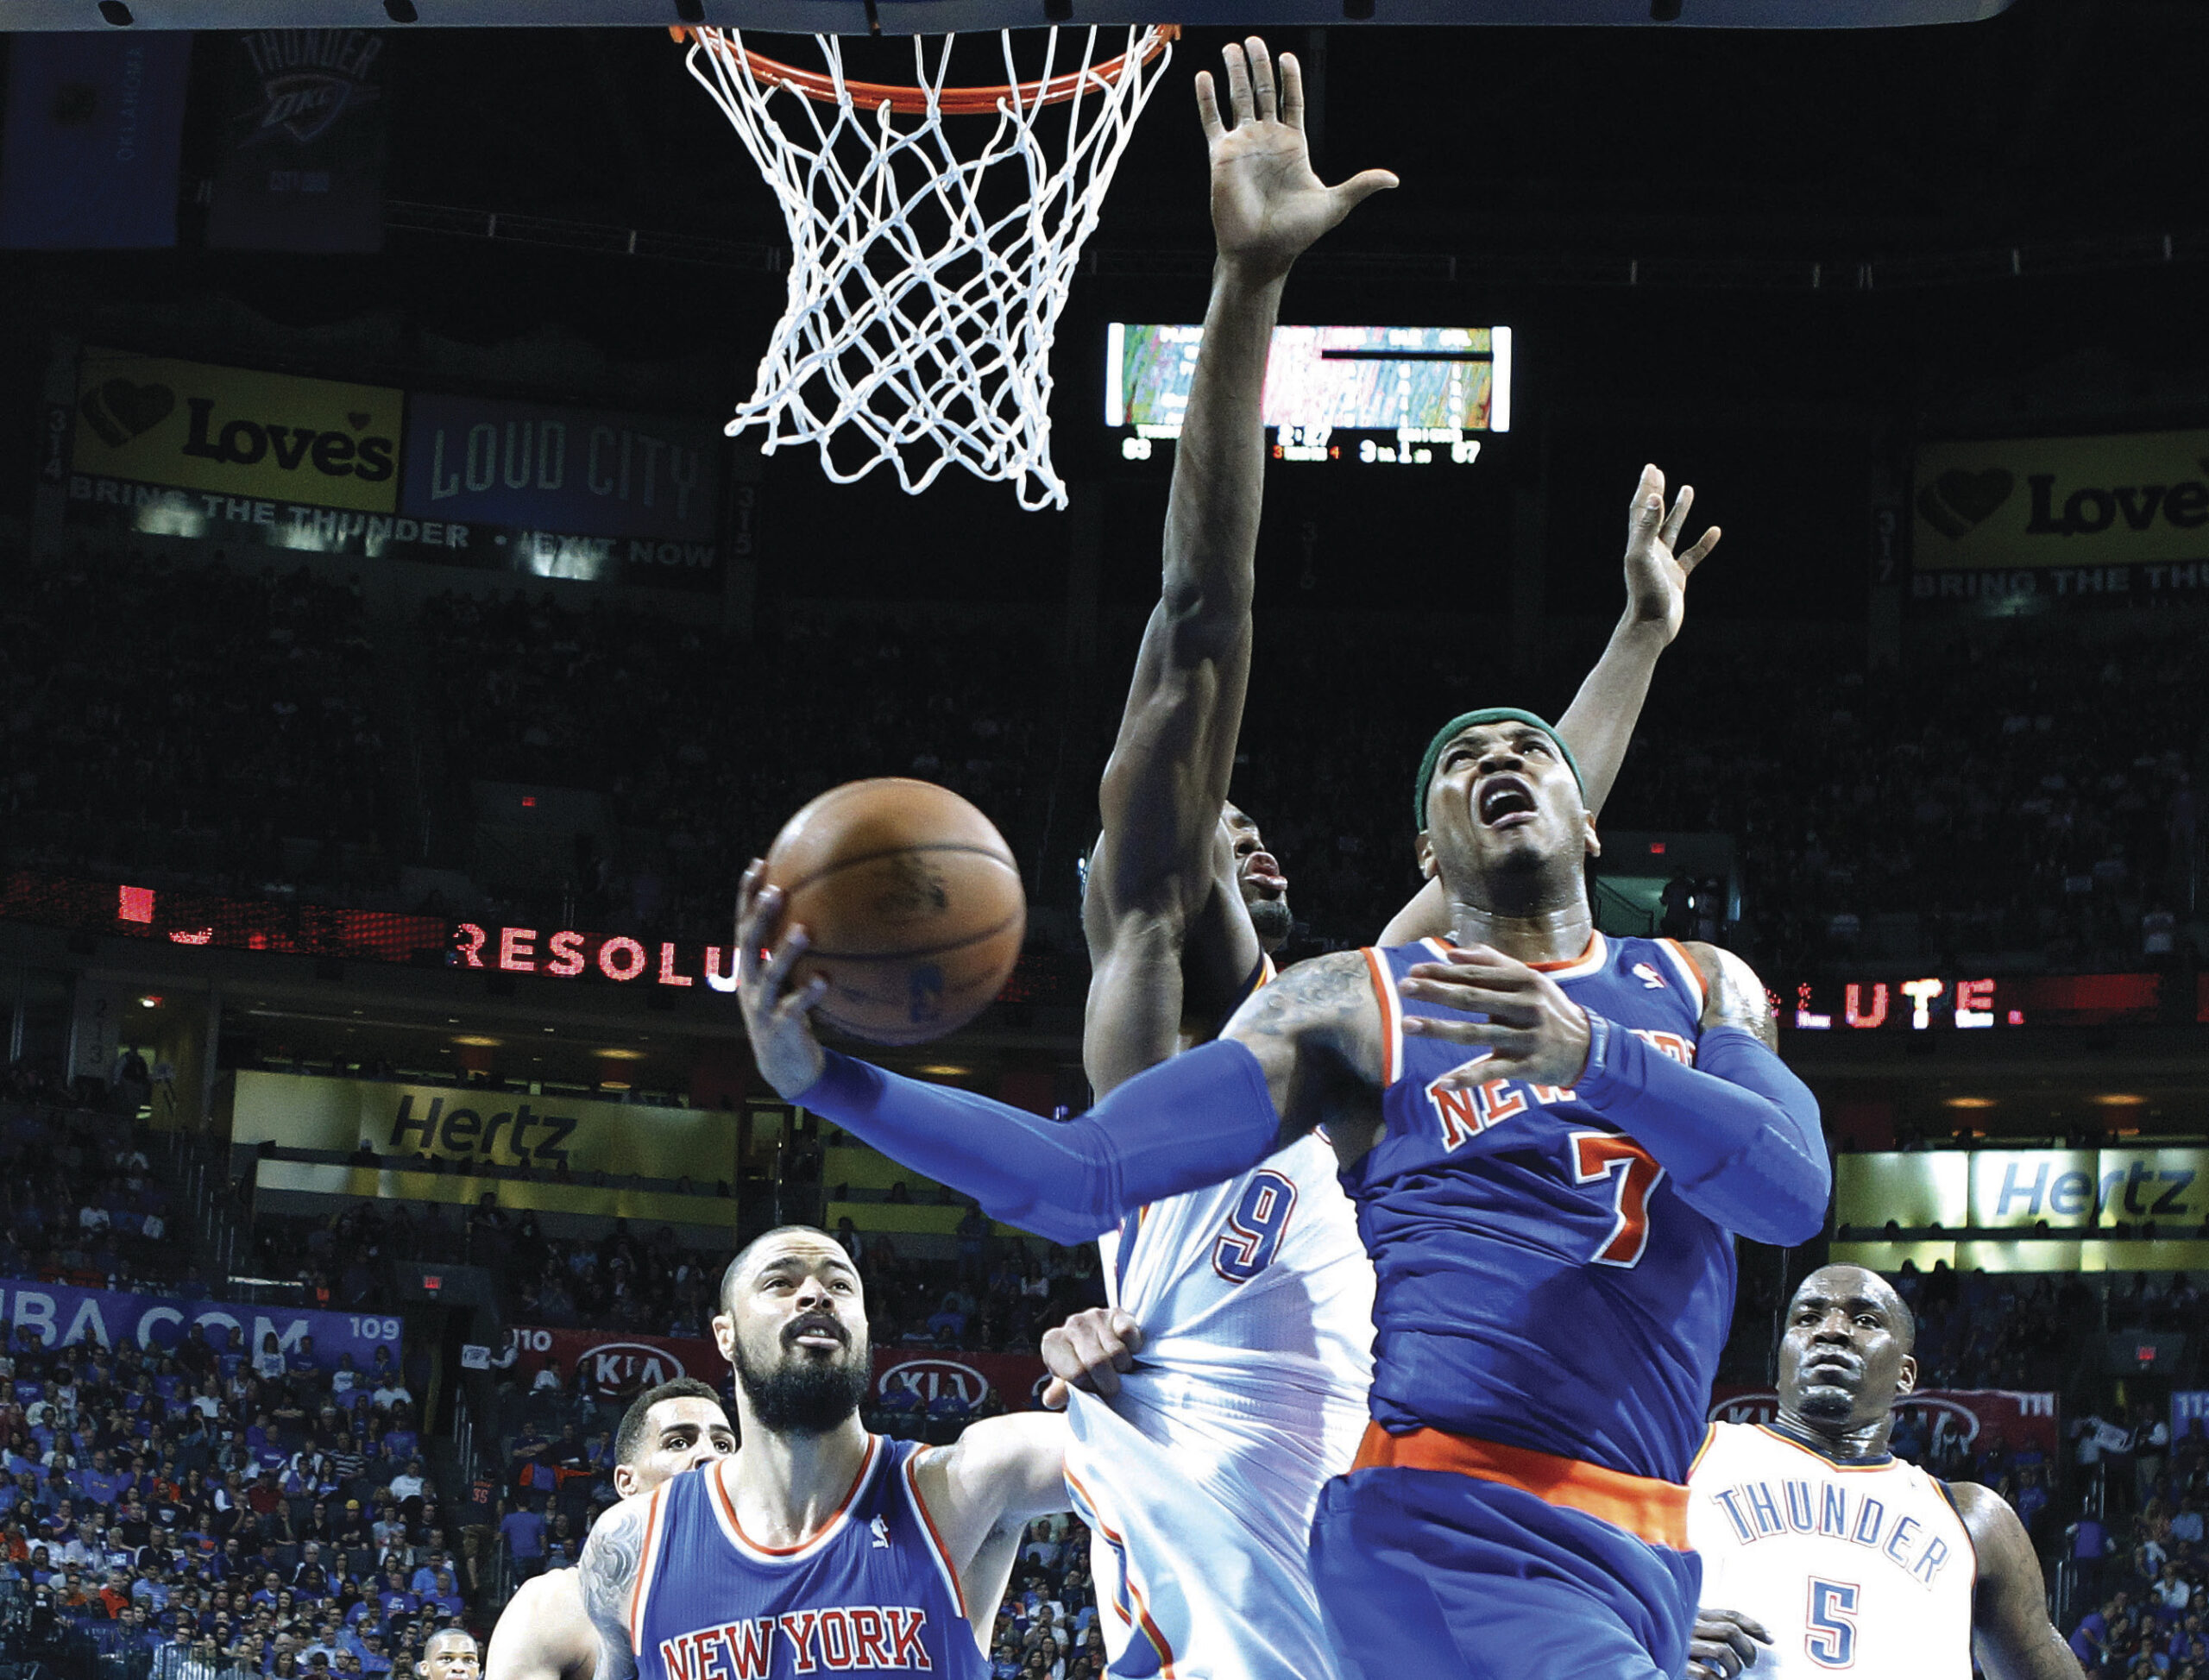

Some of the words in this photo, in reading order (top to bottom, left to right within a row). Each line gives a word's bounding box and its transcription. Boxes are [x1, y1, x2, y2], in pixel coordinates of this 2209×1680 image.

[241, 28, 383, 79] THUNDER
[431, 420, 567, 500] LOUD
[588, 426, 697, 519] CITY
[69, 476, 188, 509] BRING
[201, 494, 275, 525] THE
[287, 506, 469, 548] THUNDER
[629, 539, 715, 569] NOW
[2049, 567, 2130, 596] THE
[452, 922, 771, 992] RESOLU
[1766, 977, 2024, 1030] LUTE.
[389, 1095, 578, 1159] Hertz
[1569, 1130, 1666, 1268] 7
[1997, 1161, 2196, 1216] Hertz
[1211, 1169, 1298, 1284] 9
[349, 1317, 400, 1341] 109
[595, 1354, 665, 1386] KIA
[898, 1371, 970, 1404] KIA
[1728, 1406, 1772, 1424] KI
[1710, 1476, 1948, 1590] THUNDER
[659, 1617, 776, 1680] NEW
[777, 1605, 933, 1674] YORK
[1805, 1576, 1860, 1671] 5
